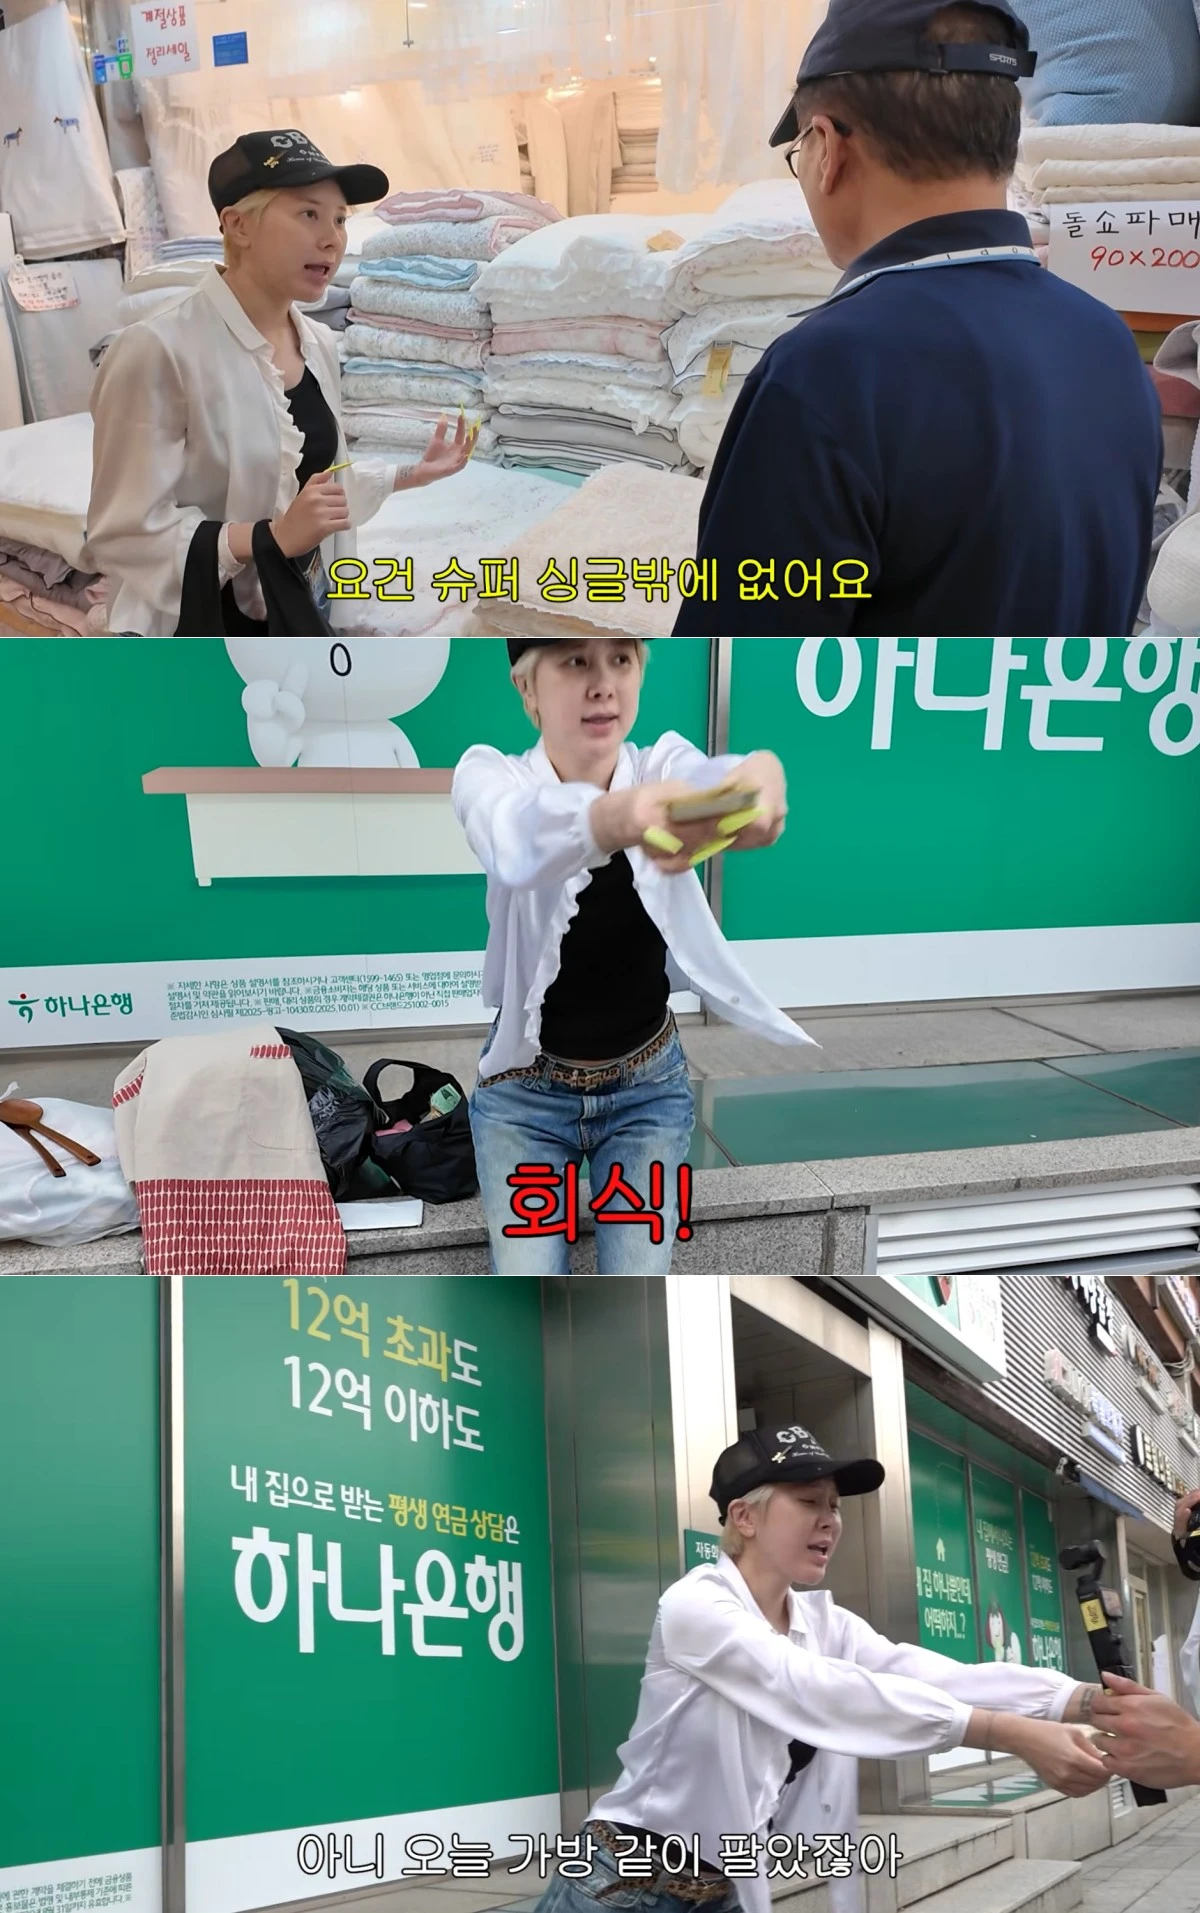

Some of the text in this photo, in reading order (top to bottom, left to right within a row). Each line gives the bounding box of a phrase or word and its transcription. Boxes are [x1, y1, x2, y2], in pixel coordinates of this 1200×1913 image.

[145, 41, 192, 66] 정리세일
[989, 53, 1018, 67] SPORTS
[230, 978, 247, 989] 상품
[405, 973, 420, 982] 또는
[391, 982, 408, 992] 또는
[46, 992, 134, 1017] 하나은행
[283, 1278, 482, 1387] 12억 초과도
[283, 1355, 484, 1452] 12억 이하도
[231, 1464, 520, 1544] 내 집으로 받는 평생 연금 상담은
[231, 1526, 524, 1662] 하나은행
